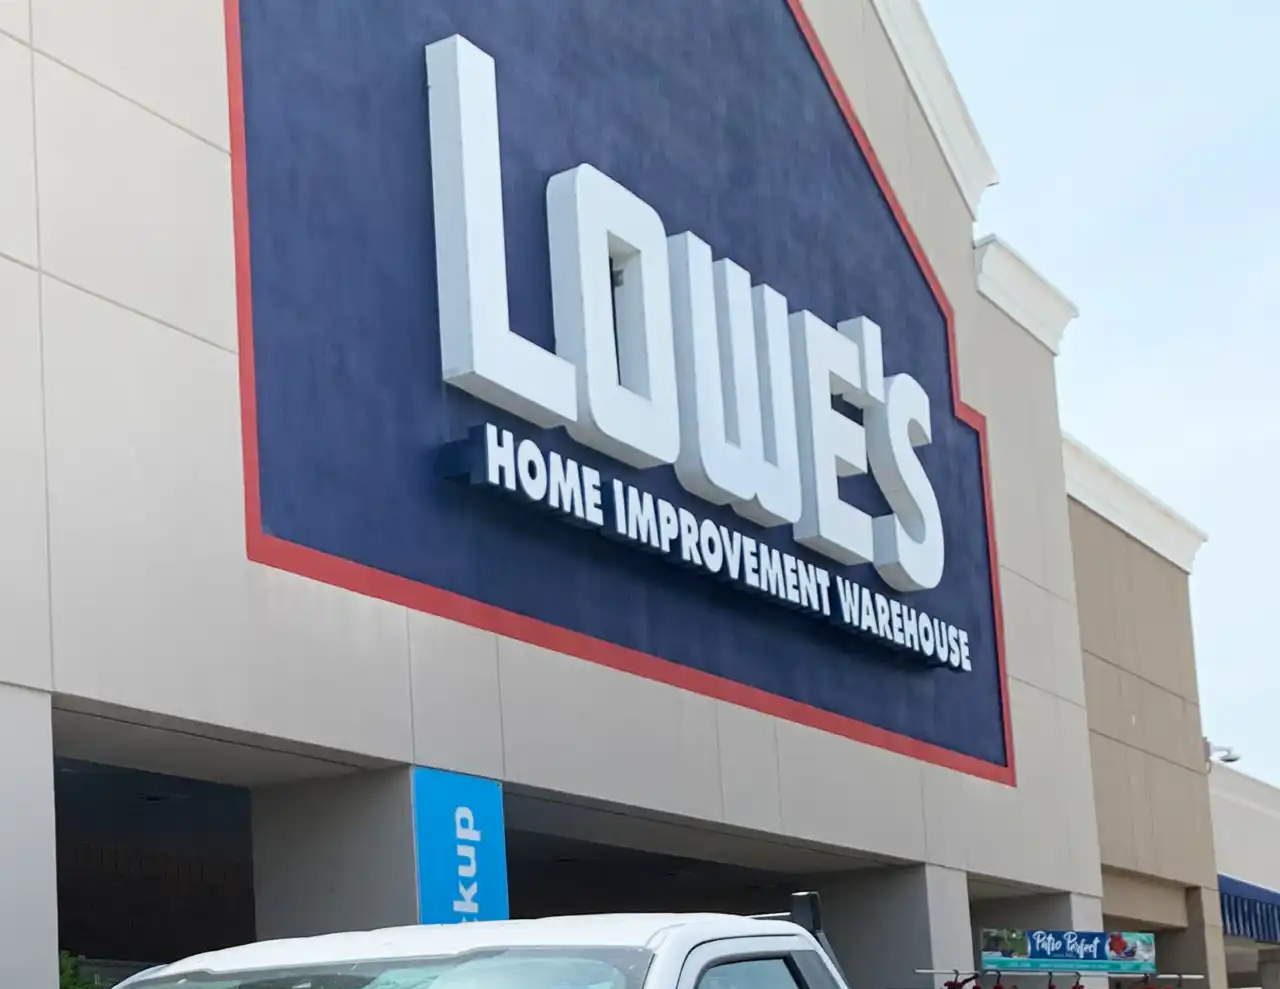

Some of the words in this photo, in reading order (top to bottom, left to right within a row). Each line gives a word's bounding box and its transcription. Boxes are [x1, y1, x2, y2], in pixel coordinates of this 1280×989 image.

[425, 33, 945, 592] LOWE'S
[486, 422, 603, 526] HOME
[612, 478, 831, 616] IMPROVEMENT
[836, 575, 972, 672] WAREHOUSE
[453, 806, 481, 923] kup
[1032, 930, 1062, 956] Patio
[1063, 931, 1101, 959] Perfect
